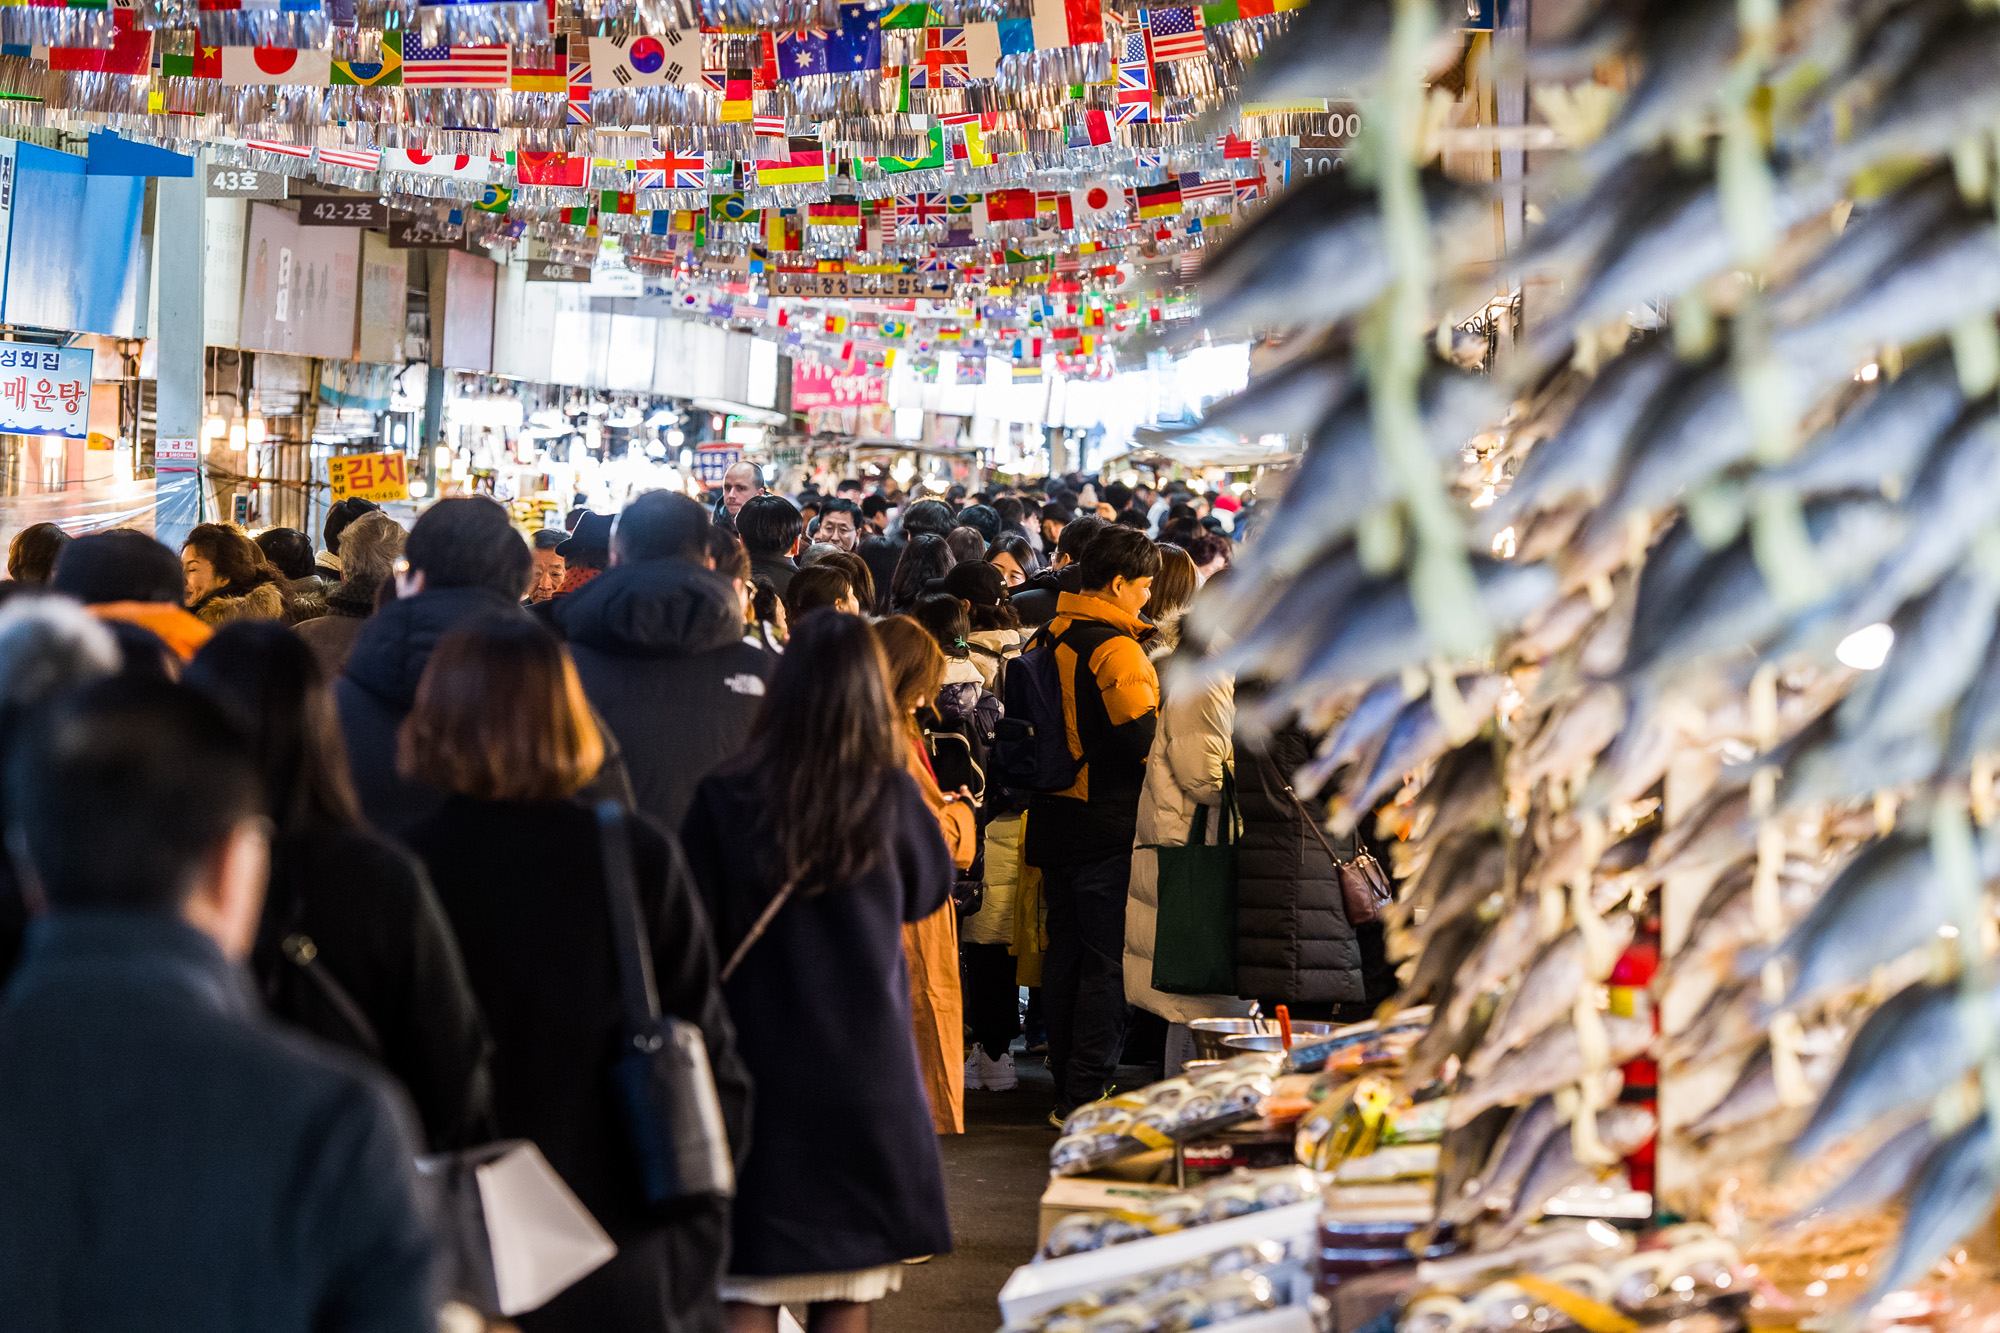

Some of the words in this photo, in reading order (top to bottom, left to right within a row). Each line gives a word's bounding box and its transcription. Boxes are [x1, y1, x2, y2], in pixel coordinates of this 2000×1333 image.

[213, 169, 260, 191] 43호
[313, 203, 373, 221] 42-2호
[0, 350, 60, 371] 성회집
[4, 376, 86, 414] 매운탕
[347, 455, 405, 490] 김치
